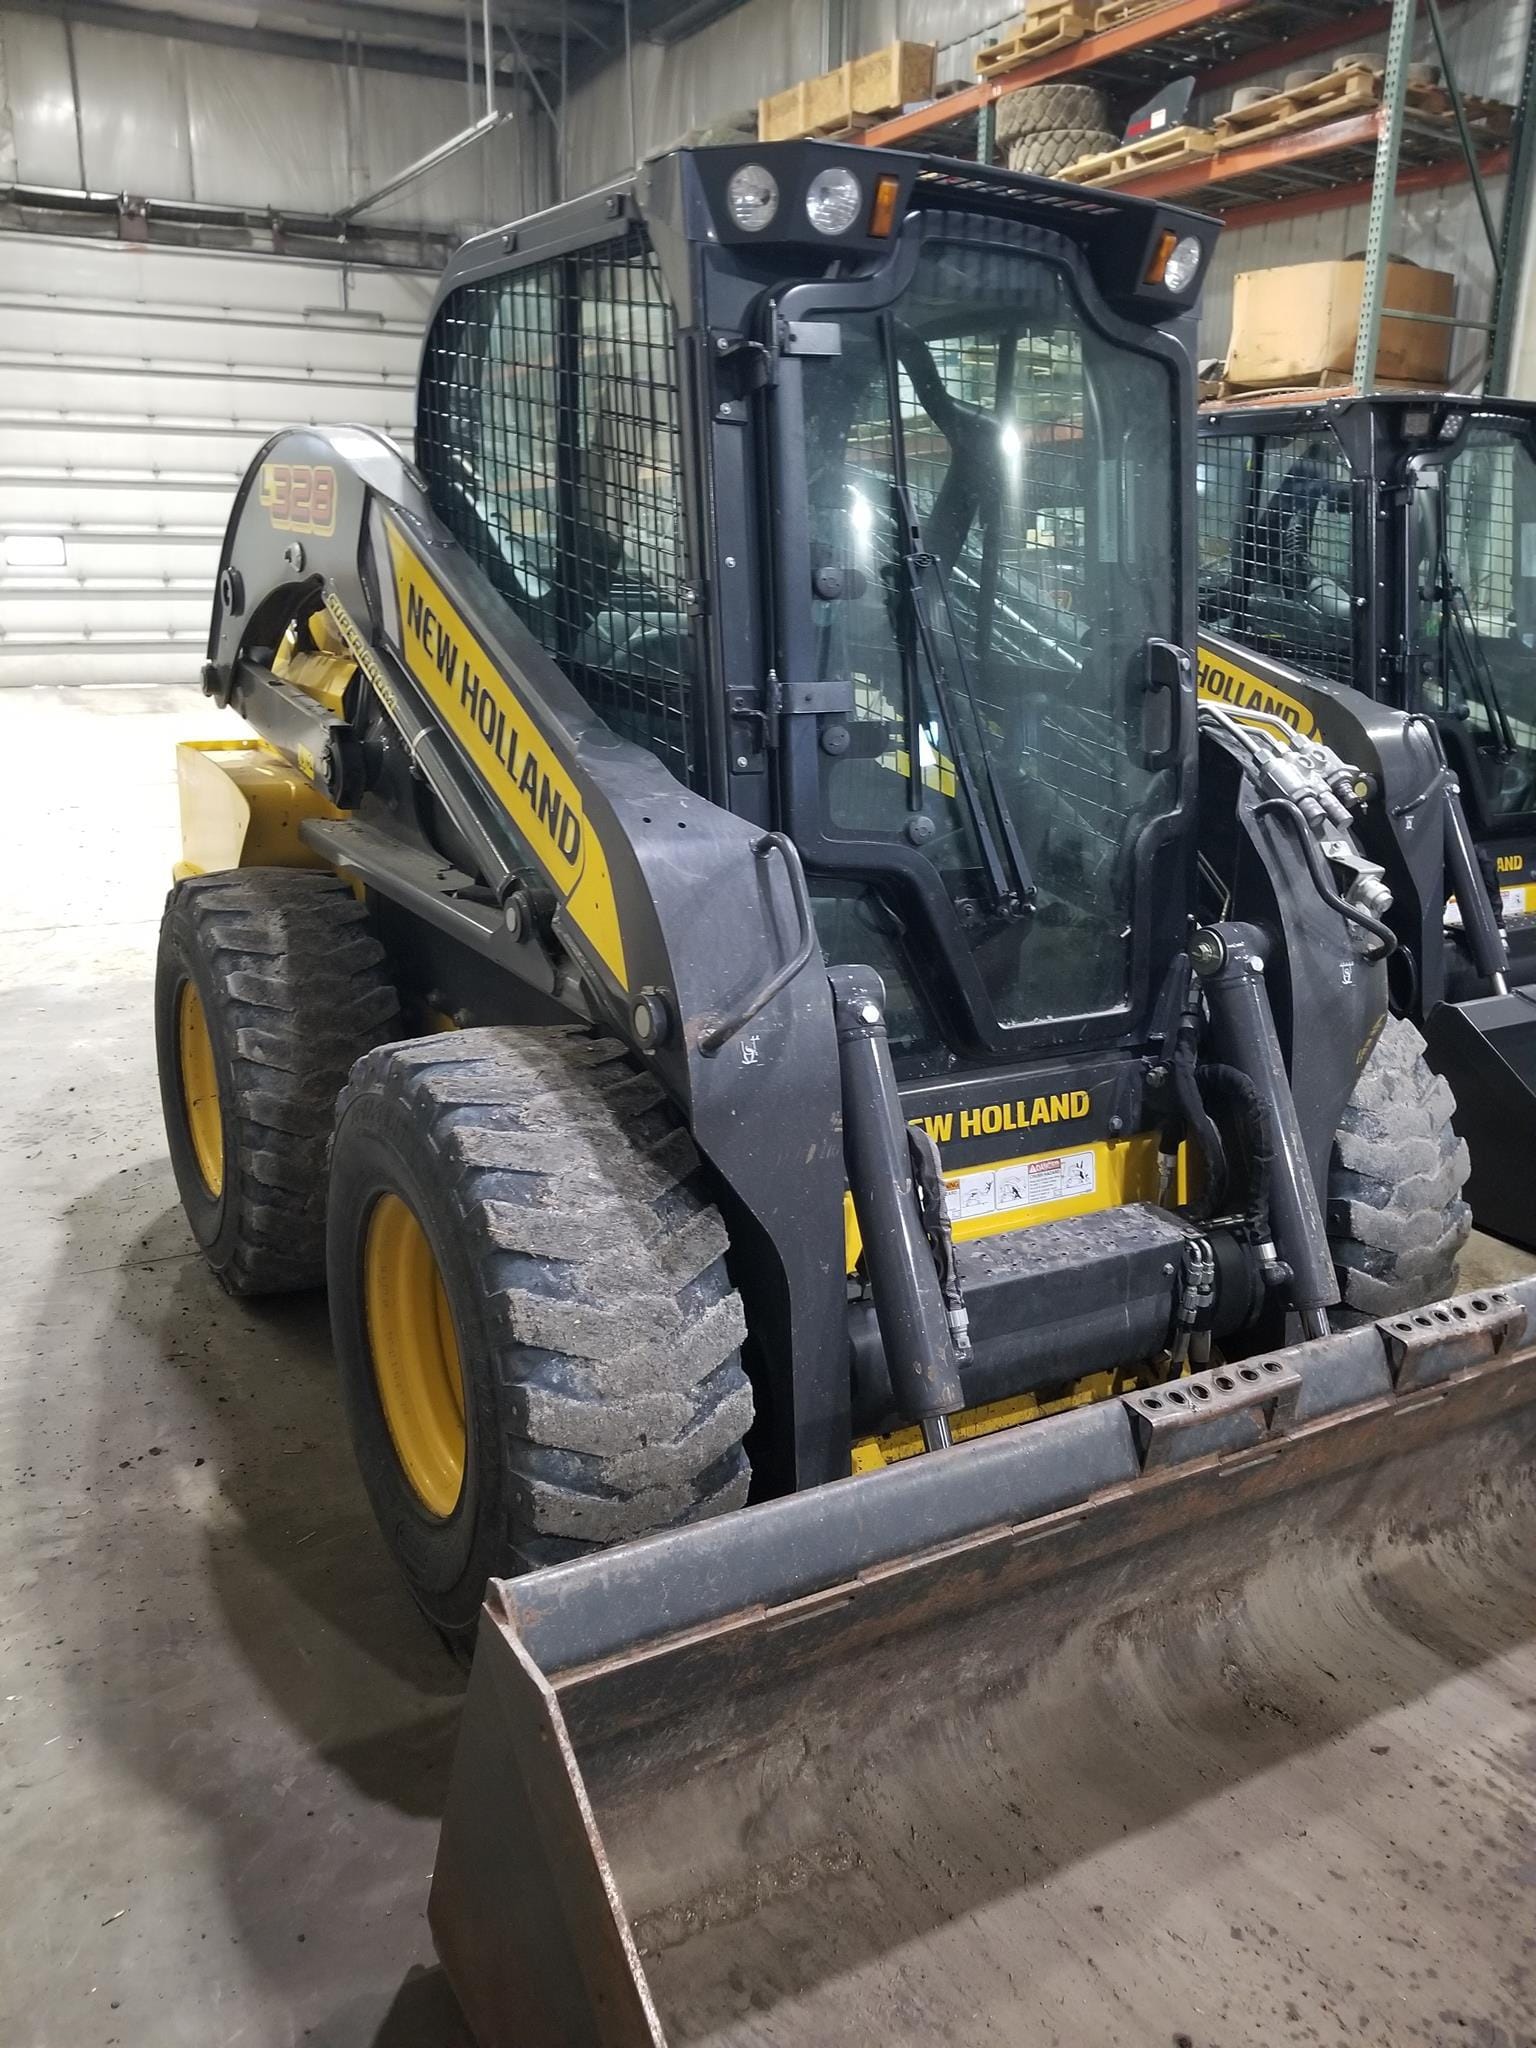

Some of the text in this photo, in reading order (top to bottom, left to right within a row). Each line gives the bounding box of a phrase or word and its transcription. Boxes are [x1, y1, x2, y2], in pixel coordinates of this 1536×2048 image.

[407, 583, 582, 867] NEW HOLLAND
[960, 1090, 1090, 1138] HOLLAND
